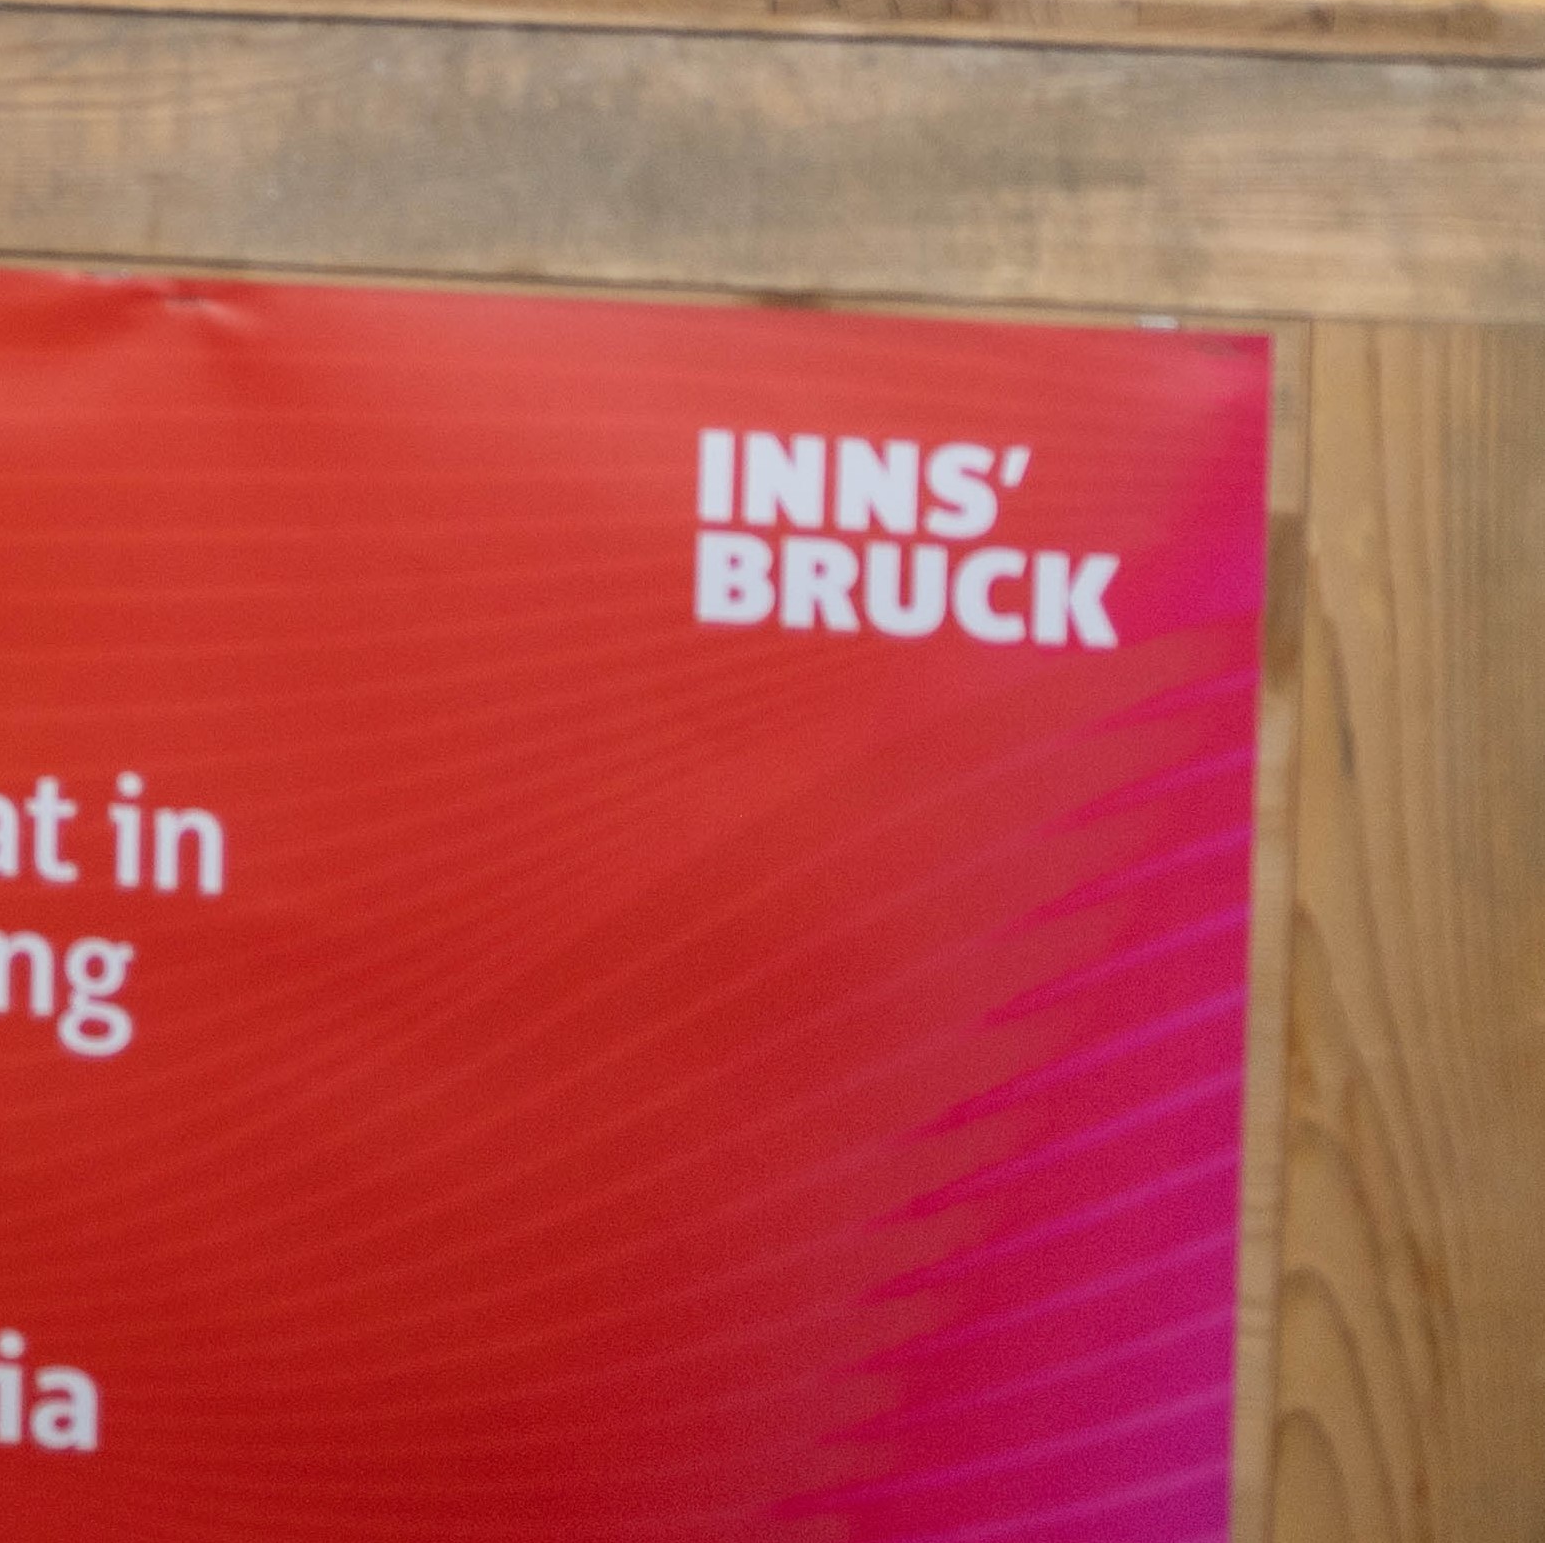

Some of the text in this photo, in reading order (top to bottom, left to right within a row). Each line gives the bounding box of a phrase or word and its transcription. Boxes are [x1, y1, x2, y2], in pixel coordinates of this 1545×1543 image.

[697, 427, 1032, 540] INNS'
[694, 529, 1121, 649] BRUCK
[108, 771, 226, 897] in
